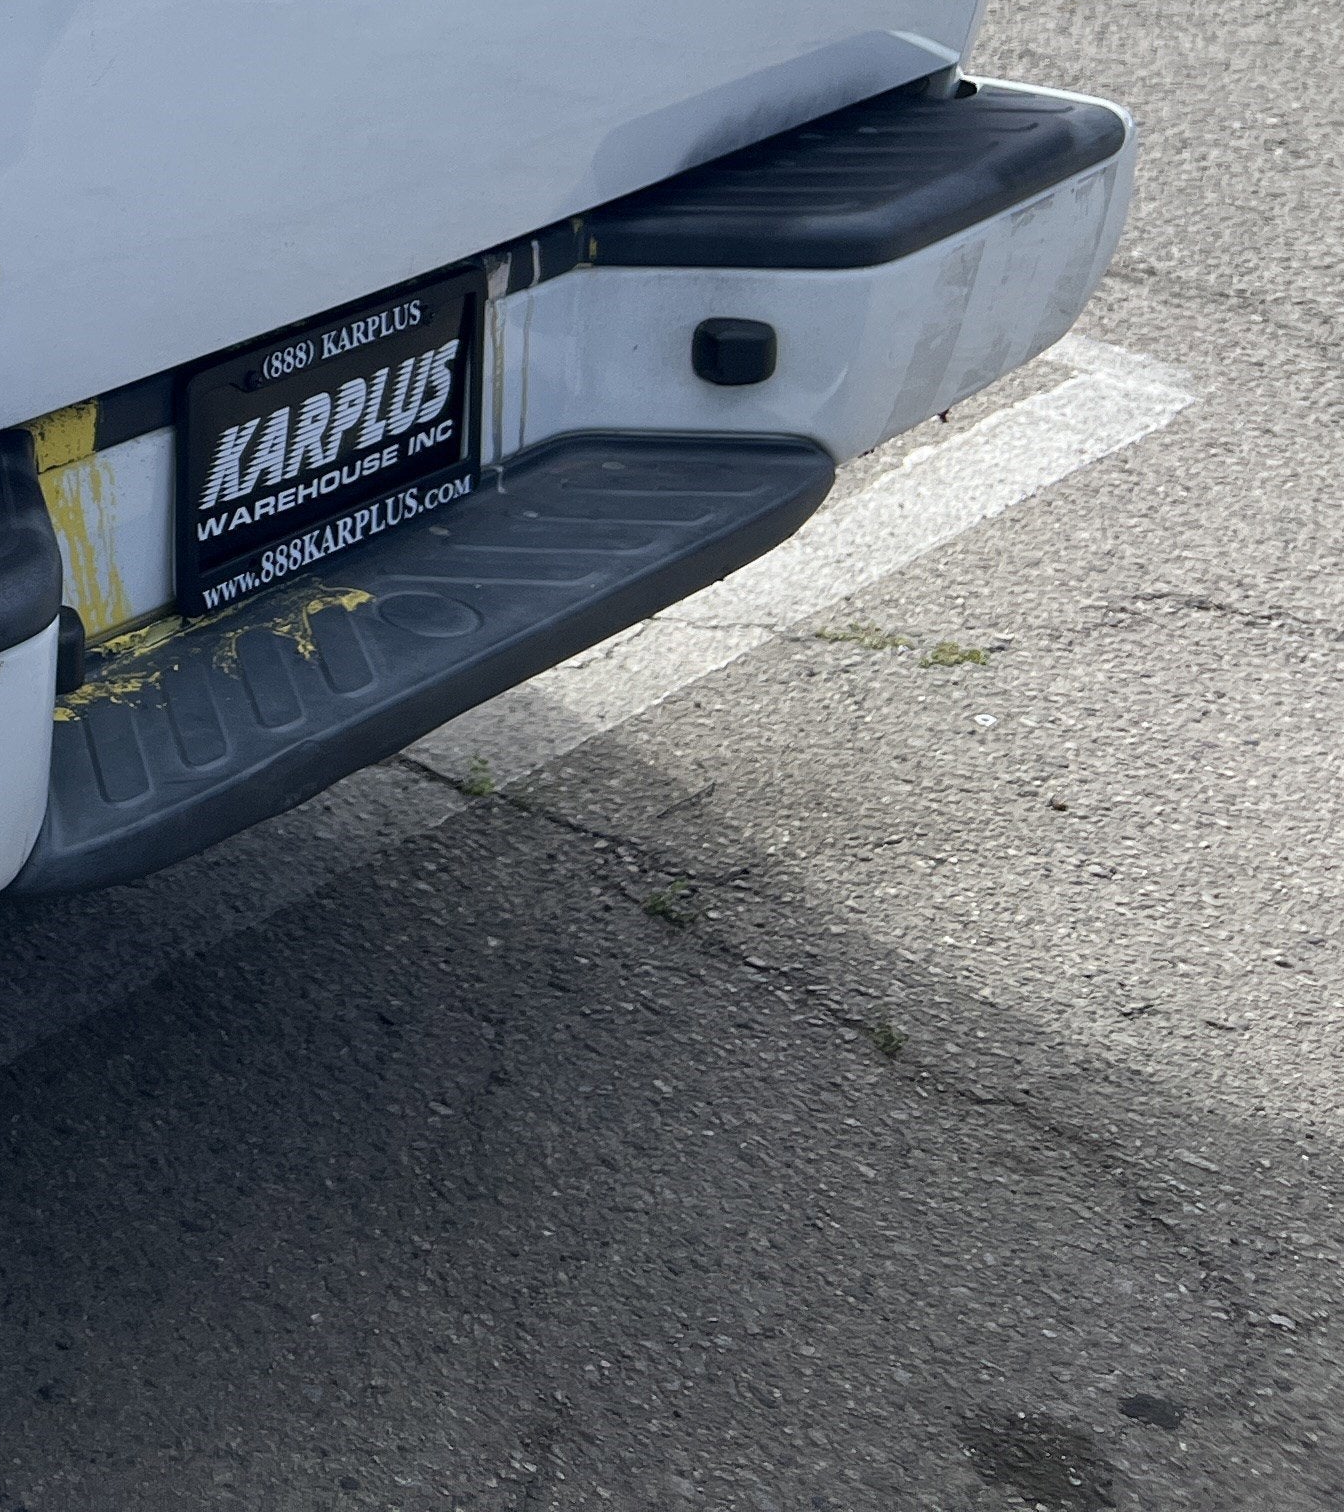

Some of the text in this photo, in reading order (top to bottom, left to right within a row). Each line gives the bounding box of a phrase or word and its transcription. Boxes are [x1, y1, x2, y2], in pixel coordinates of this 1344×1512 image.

[263, 300, 421, 380] (888) KARPLUS
[197, 420, 454, 542] WAREHOUSE INC
[199, 339, 460, 510] KARPLUS
